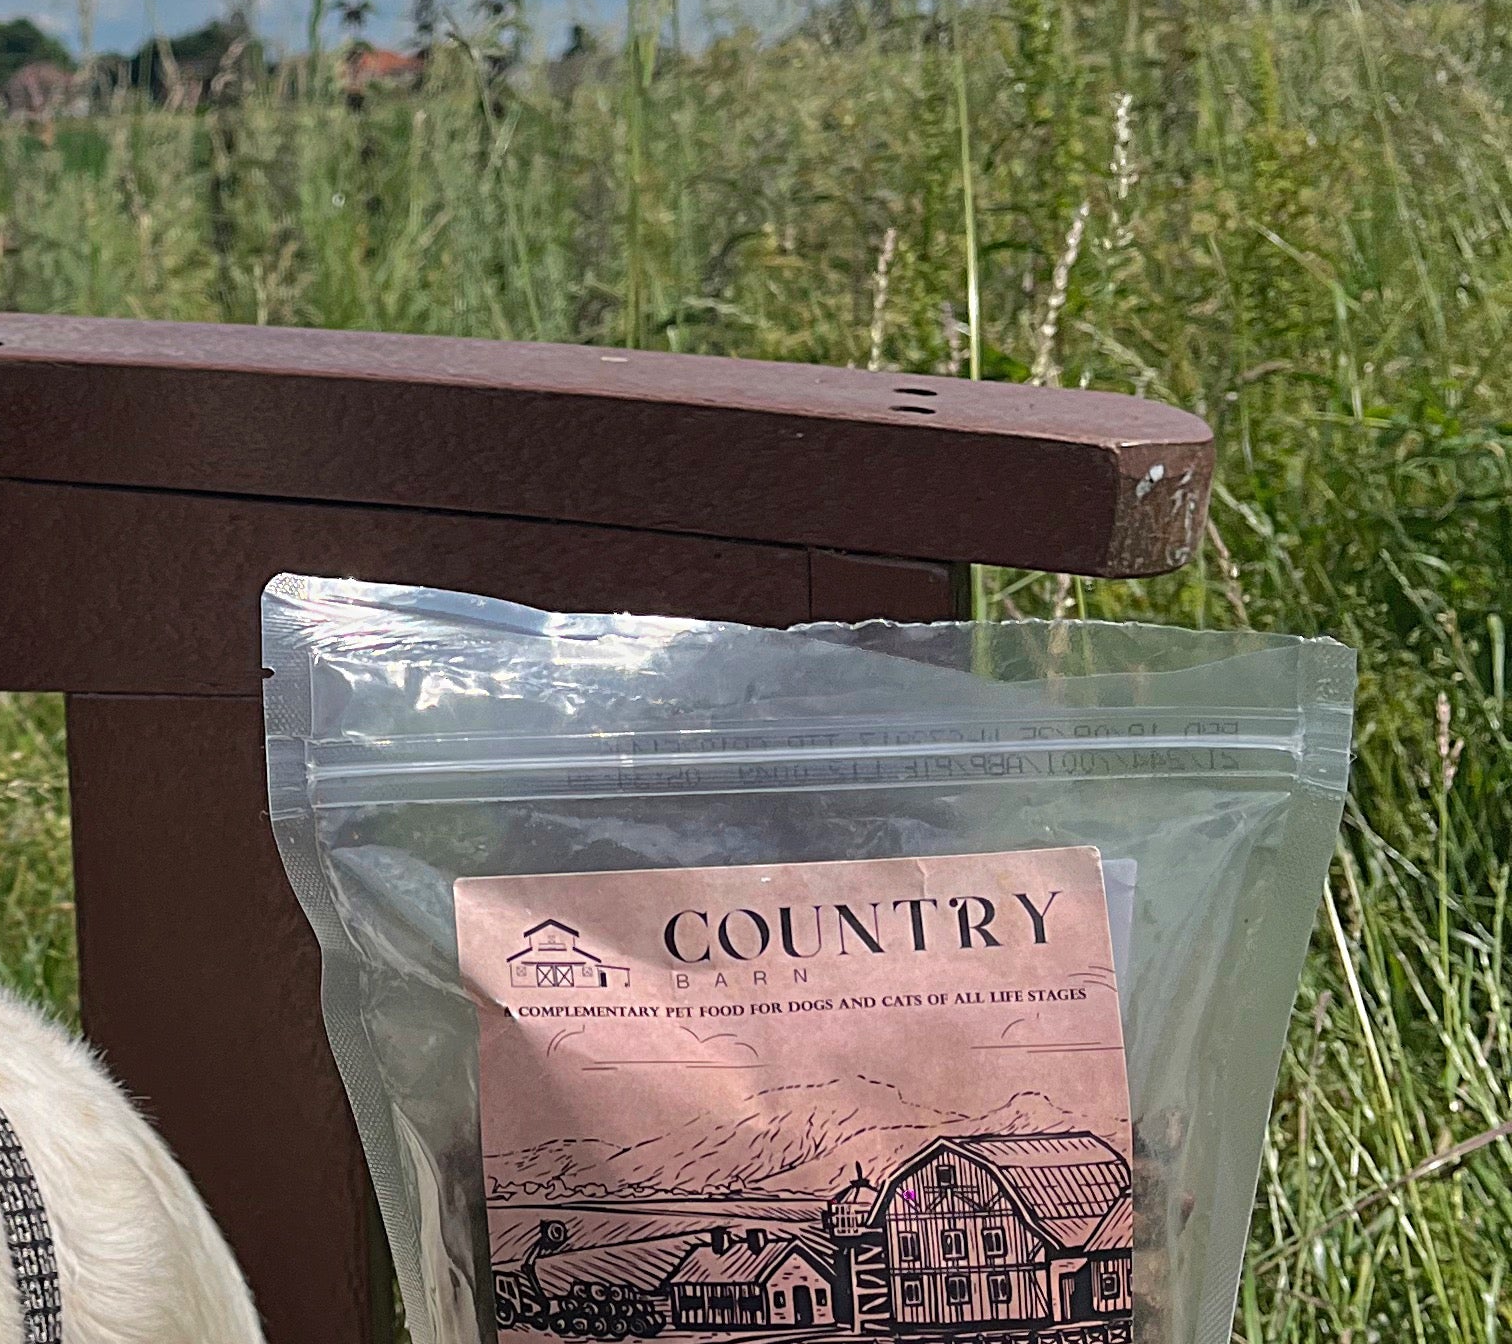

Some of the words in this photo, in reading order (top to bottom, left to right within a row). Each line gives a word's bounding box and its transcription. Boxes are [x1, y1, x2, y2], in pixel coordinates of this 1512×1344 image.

[664, 891, 1062, 963] COUNTRY
[676, 967, 808, 989] BARN
[519, 1006, 660, 1019] COMPLEMENTARY
[666, 1006, 694, 1018] PET
[700, 1004, 745, 1017] FOOD
[750, 1002, 783, 1015] FOR
[788, 999, 833, 1013] DOGS
[839, 996, 876, 1010] AND
[882, 994, 922, 1008] CATS
[927, 993, 949, 1006] OF
[954, 991, 985, 1005] ALL
[990, 990, 1023, 1003] LIFE
[1028, 988, 1087, 1002] STAGES
